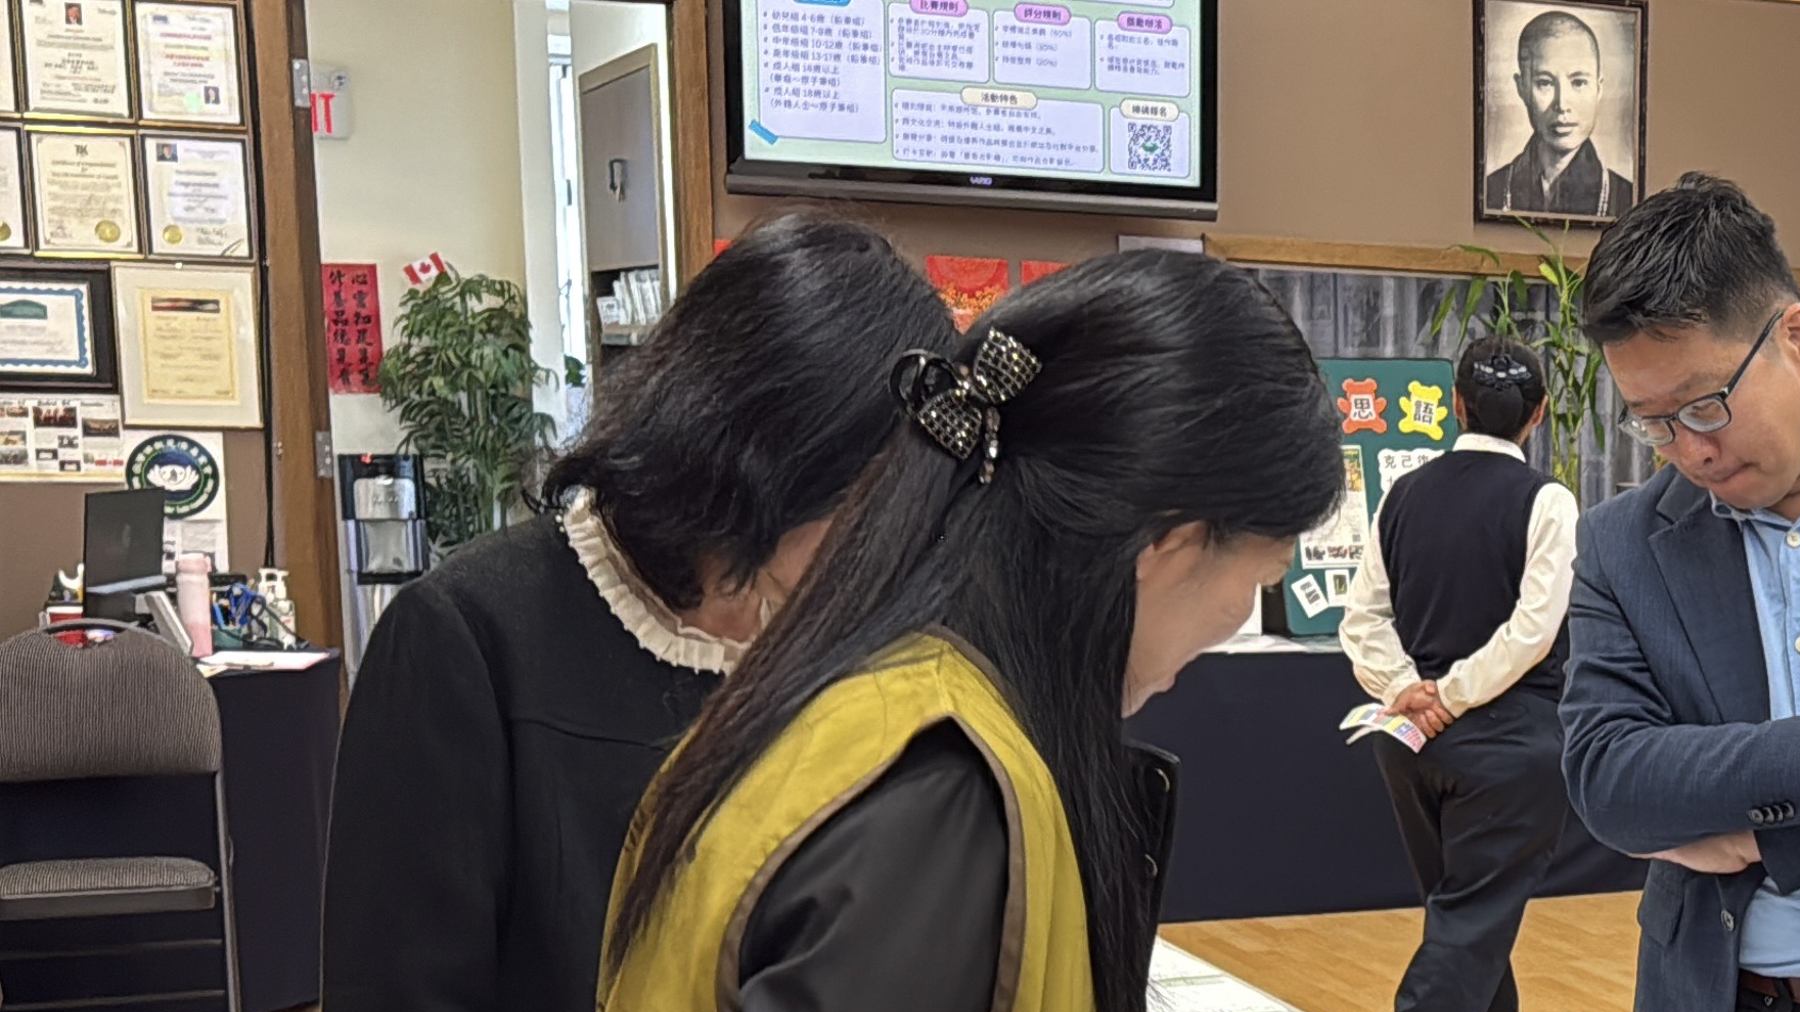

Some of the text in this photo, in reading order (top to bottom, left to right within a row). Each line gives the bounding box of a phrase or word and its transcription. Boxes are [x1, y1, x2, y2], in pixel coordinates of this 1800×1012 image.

[311, 93, 336, 134] IT
[1353, 397, 1434, 425] 思 語
